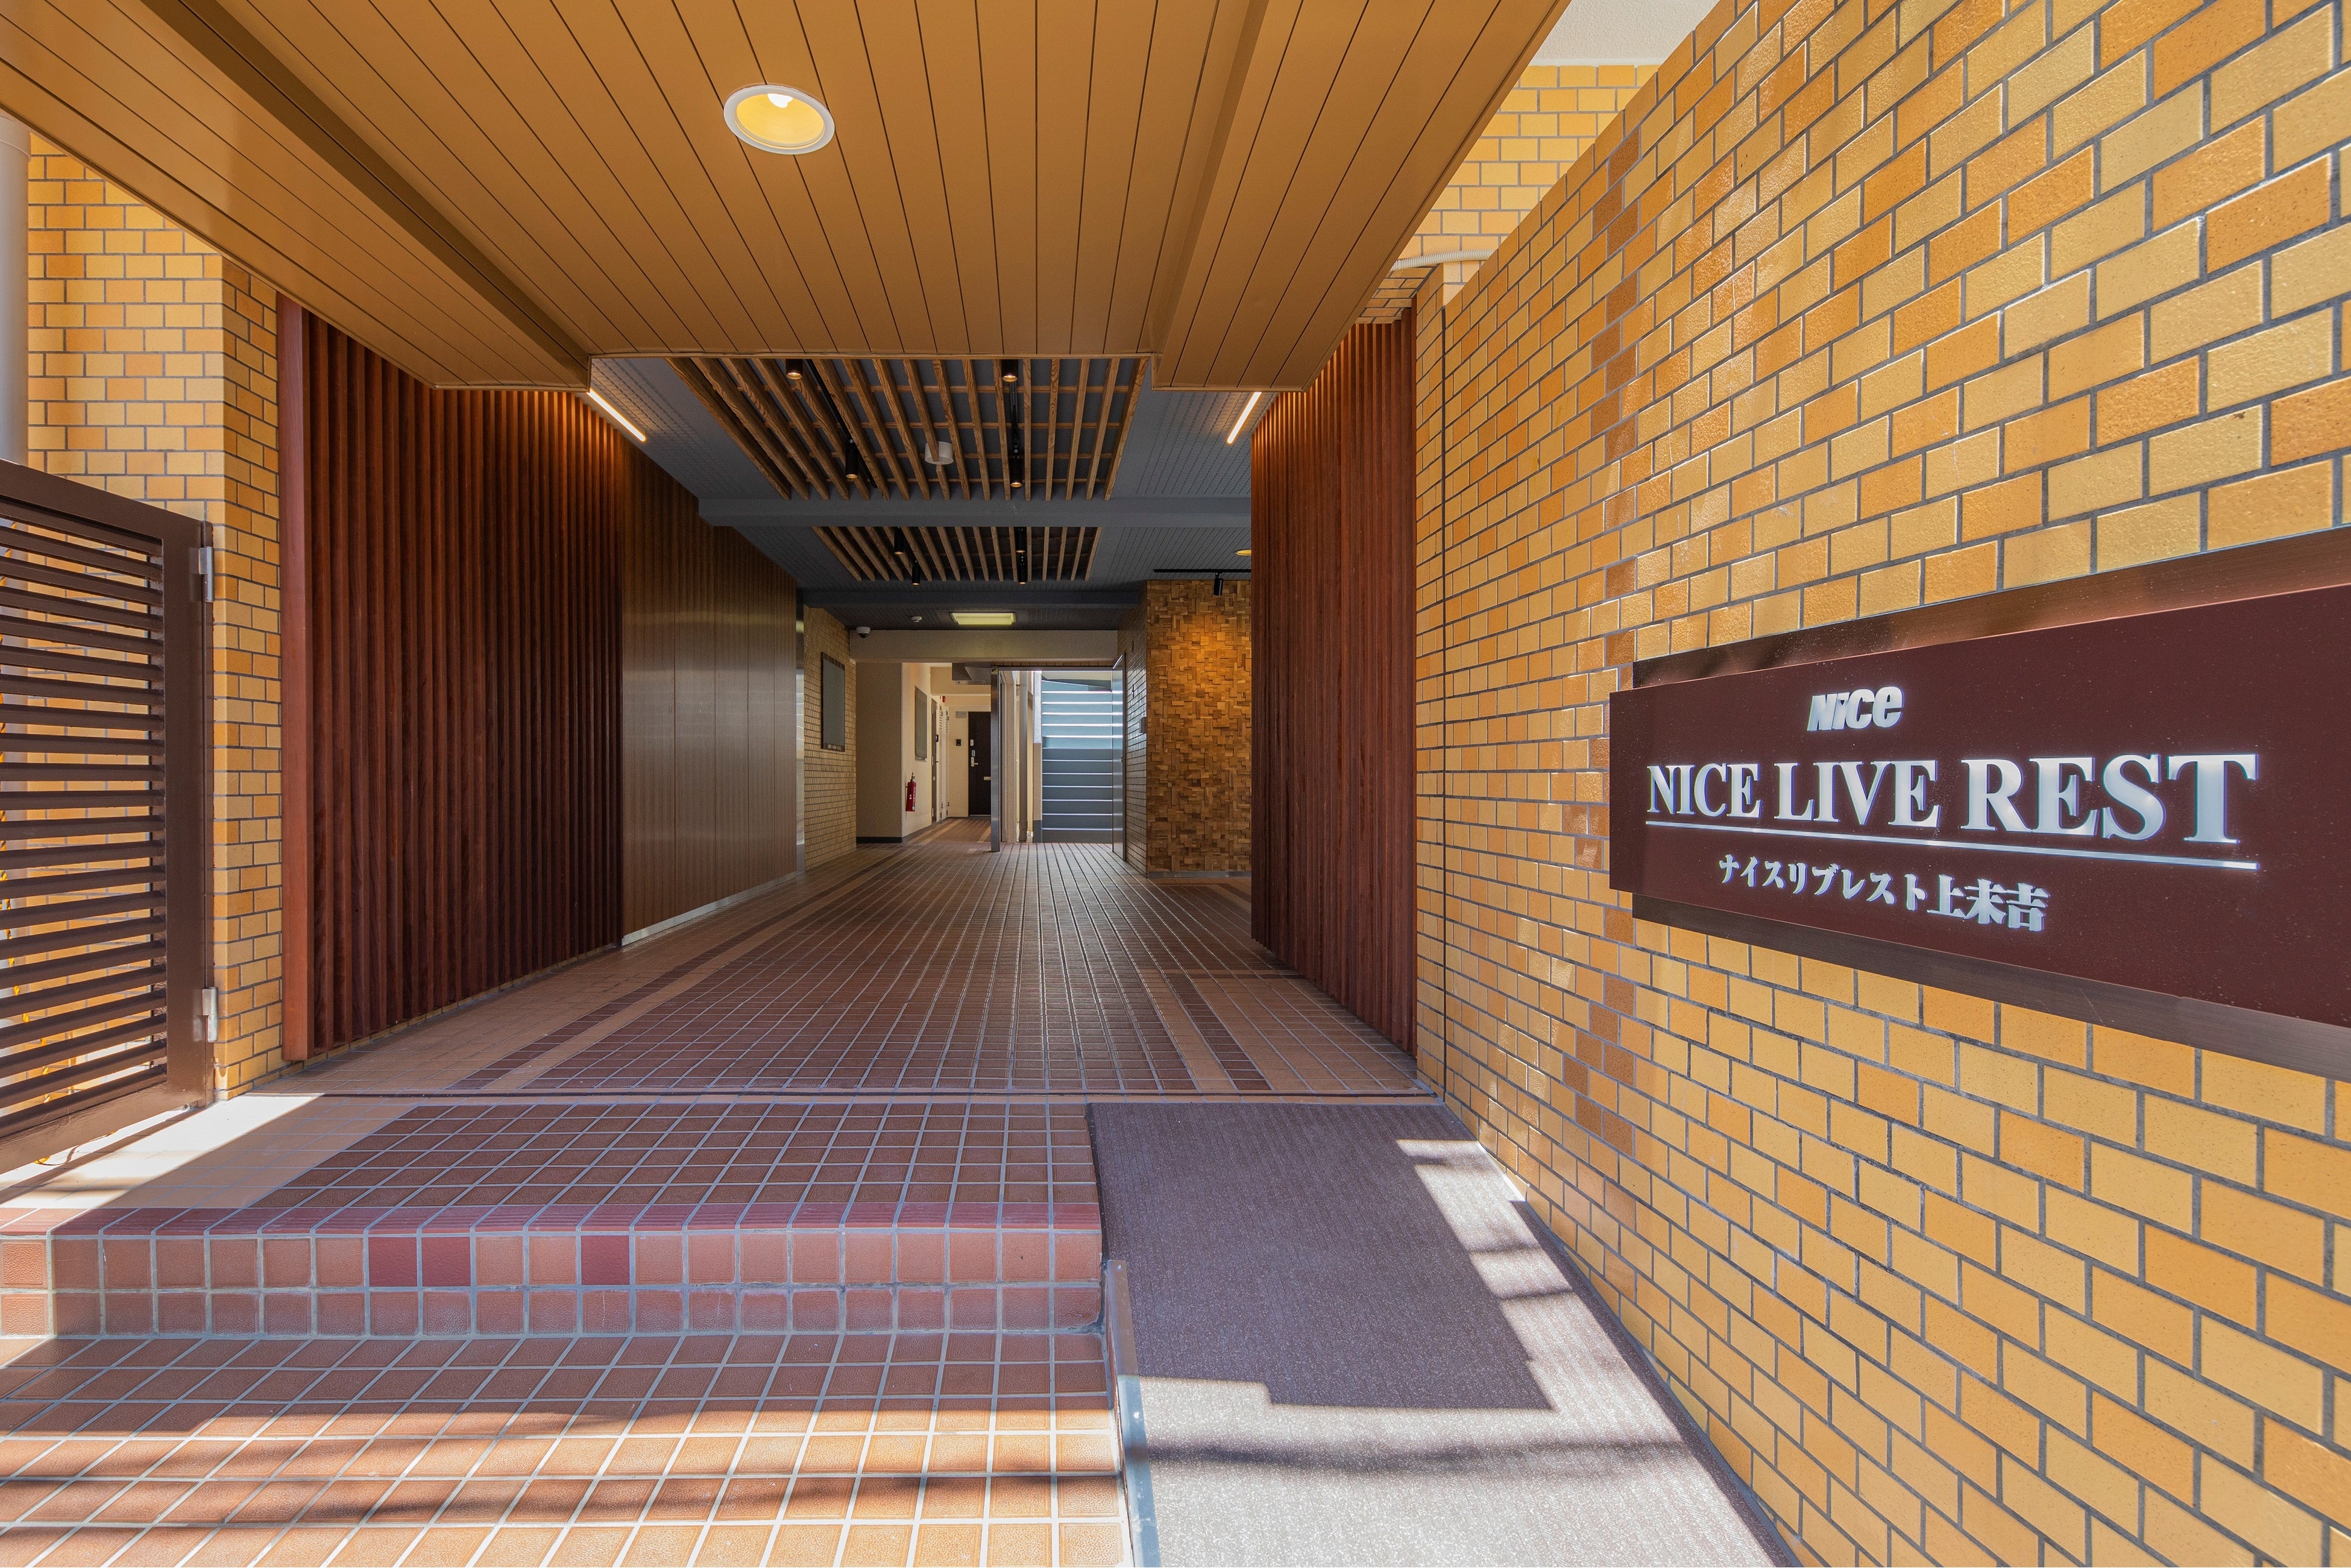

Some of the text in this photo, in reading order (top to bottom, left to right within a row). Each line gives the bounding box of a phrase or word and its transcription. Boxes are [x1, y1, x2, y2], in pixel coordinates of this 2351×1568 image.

[1647, 754, 2258, 843] NICE LIVE REST
[1719, 854, 2051, 933] ナイスリブレスト上末吉
